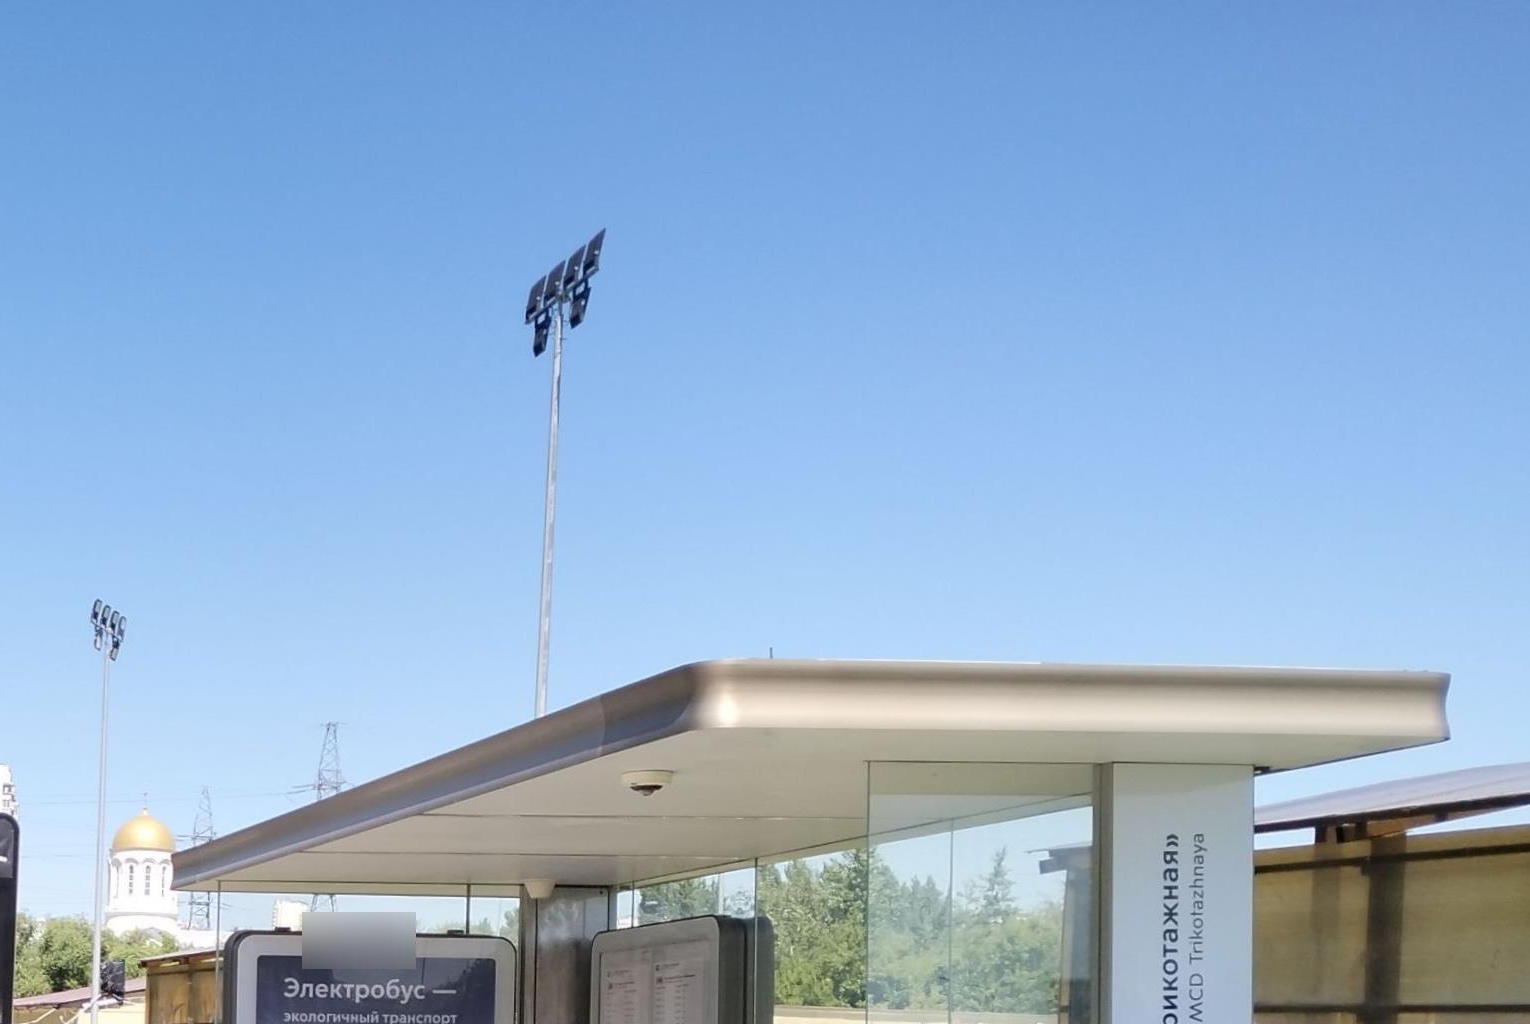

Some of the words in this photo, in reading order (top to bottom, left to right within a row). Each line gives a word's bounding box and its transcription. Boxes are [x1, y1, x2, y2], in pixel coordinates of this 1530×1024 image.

[1188, 832, 1208, 966] Trikotazhnaya
[283, 976, 426, 1004] Электробус
[1188, 972, 1204, 1023] MCD
[282, 1010, 380, 1024] экологичный
